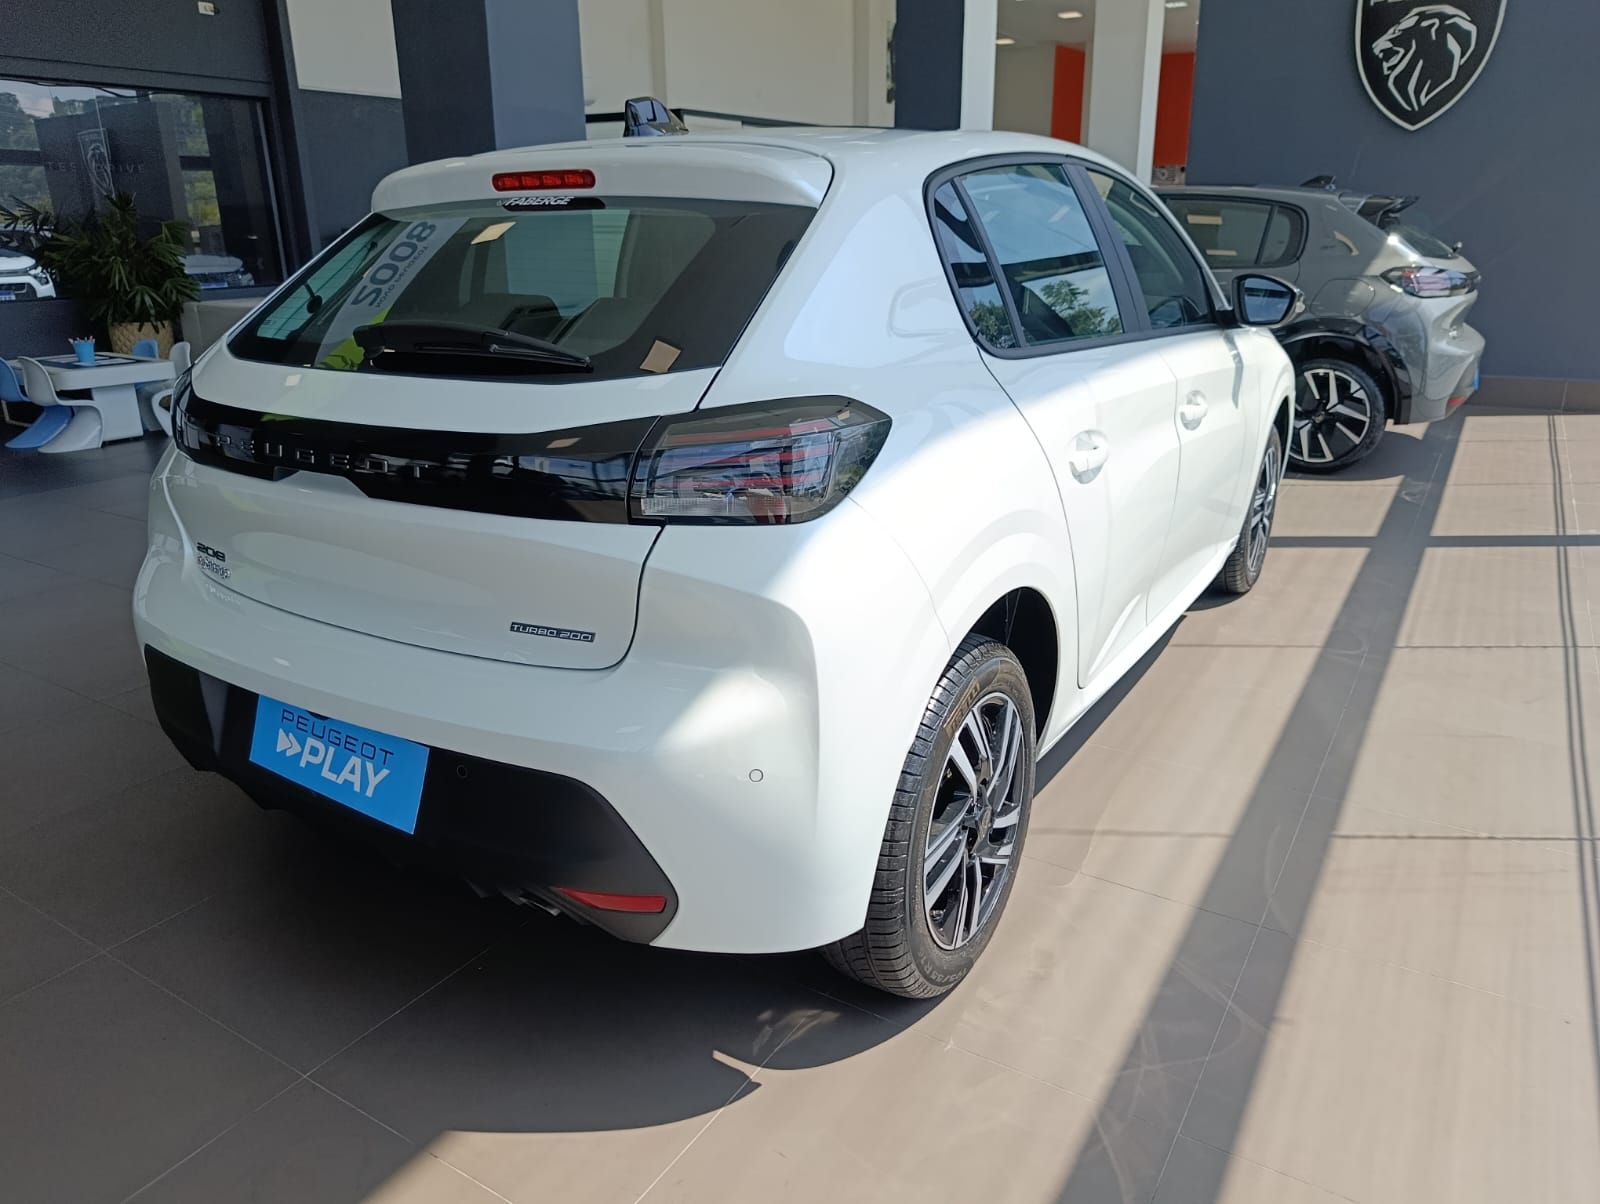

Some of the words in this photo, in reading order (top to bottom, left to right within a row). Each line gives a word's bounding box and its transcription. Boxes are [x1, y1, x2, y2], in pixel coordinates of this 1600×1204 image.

[505, 196, 574, 207] FABERGE
[216, 434, 430, 479] PEUGEOT
[197, 542, 226, 563] 208
[511, 623, 557, 637] TURBO
[560, 631, 592, 641] 200
[281, 708, 394, 766] PEUGEOT
[300, 737, 391, 798] PLAY
